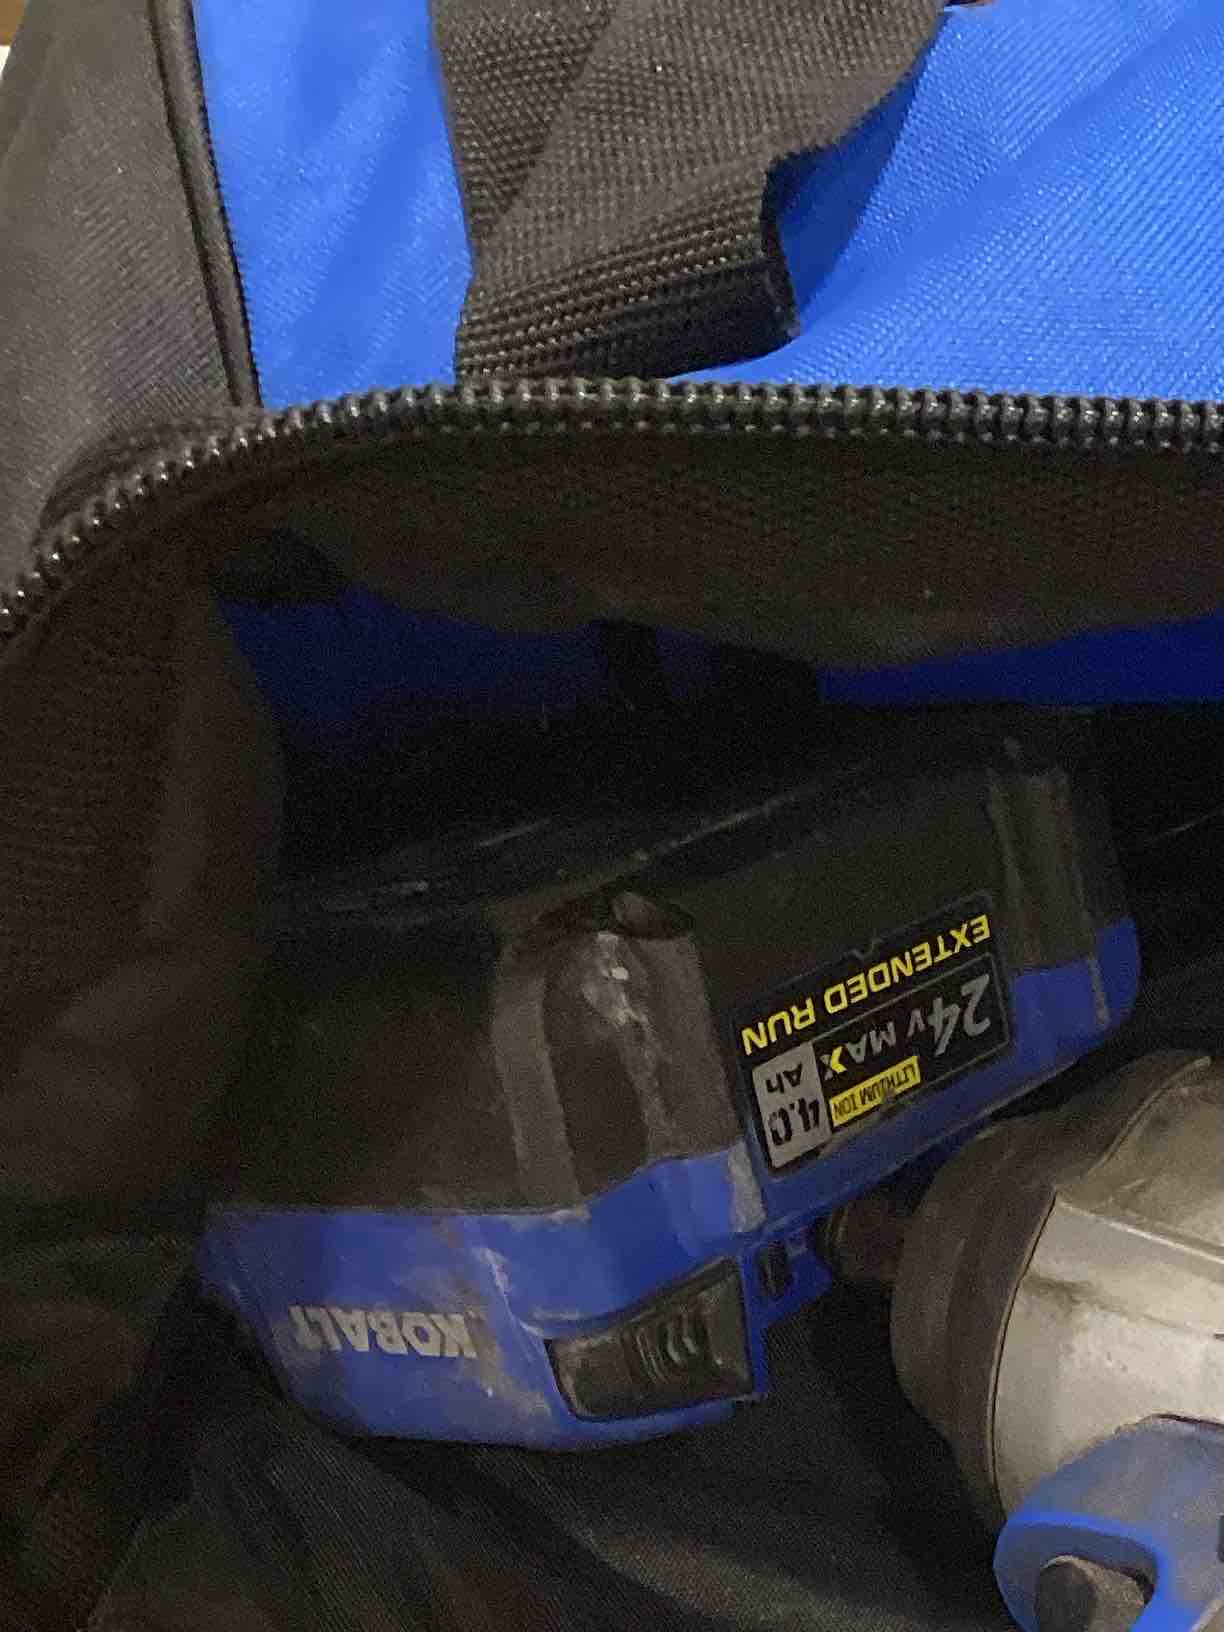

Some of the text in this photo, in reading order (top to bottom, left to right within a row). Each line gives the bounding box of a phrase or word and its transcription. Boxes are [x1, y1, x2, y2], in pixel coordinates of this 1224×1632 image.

[741, 914, 991, 1055] EXTENDED RUN
[765, 1063, 804, 1094] Ah
[820, 1021, 897, 1081] MAX
[832, 1064, 917, 1121] LITHIUM ION
[767, 1098, 820, 1146] 4.0
[288, 1305, 477, 1358] KOBALT
